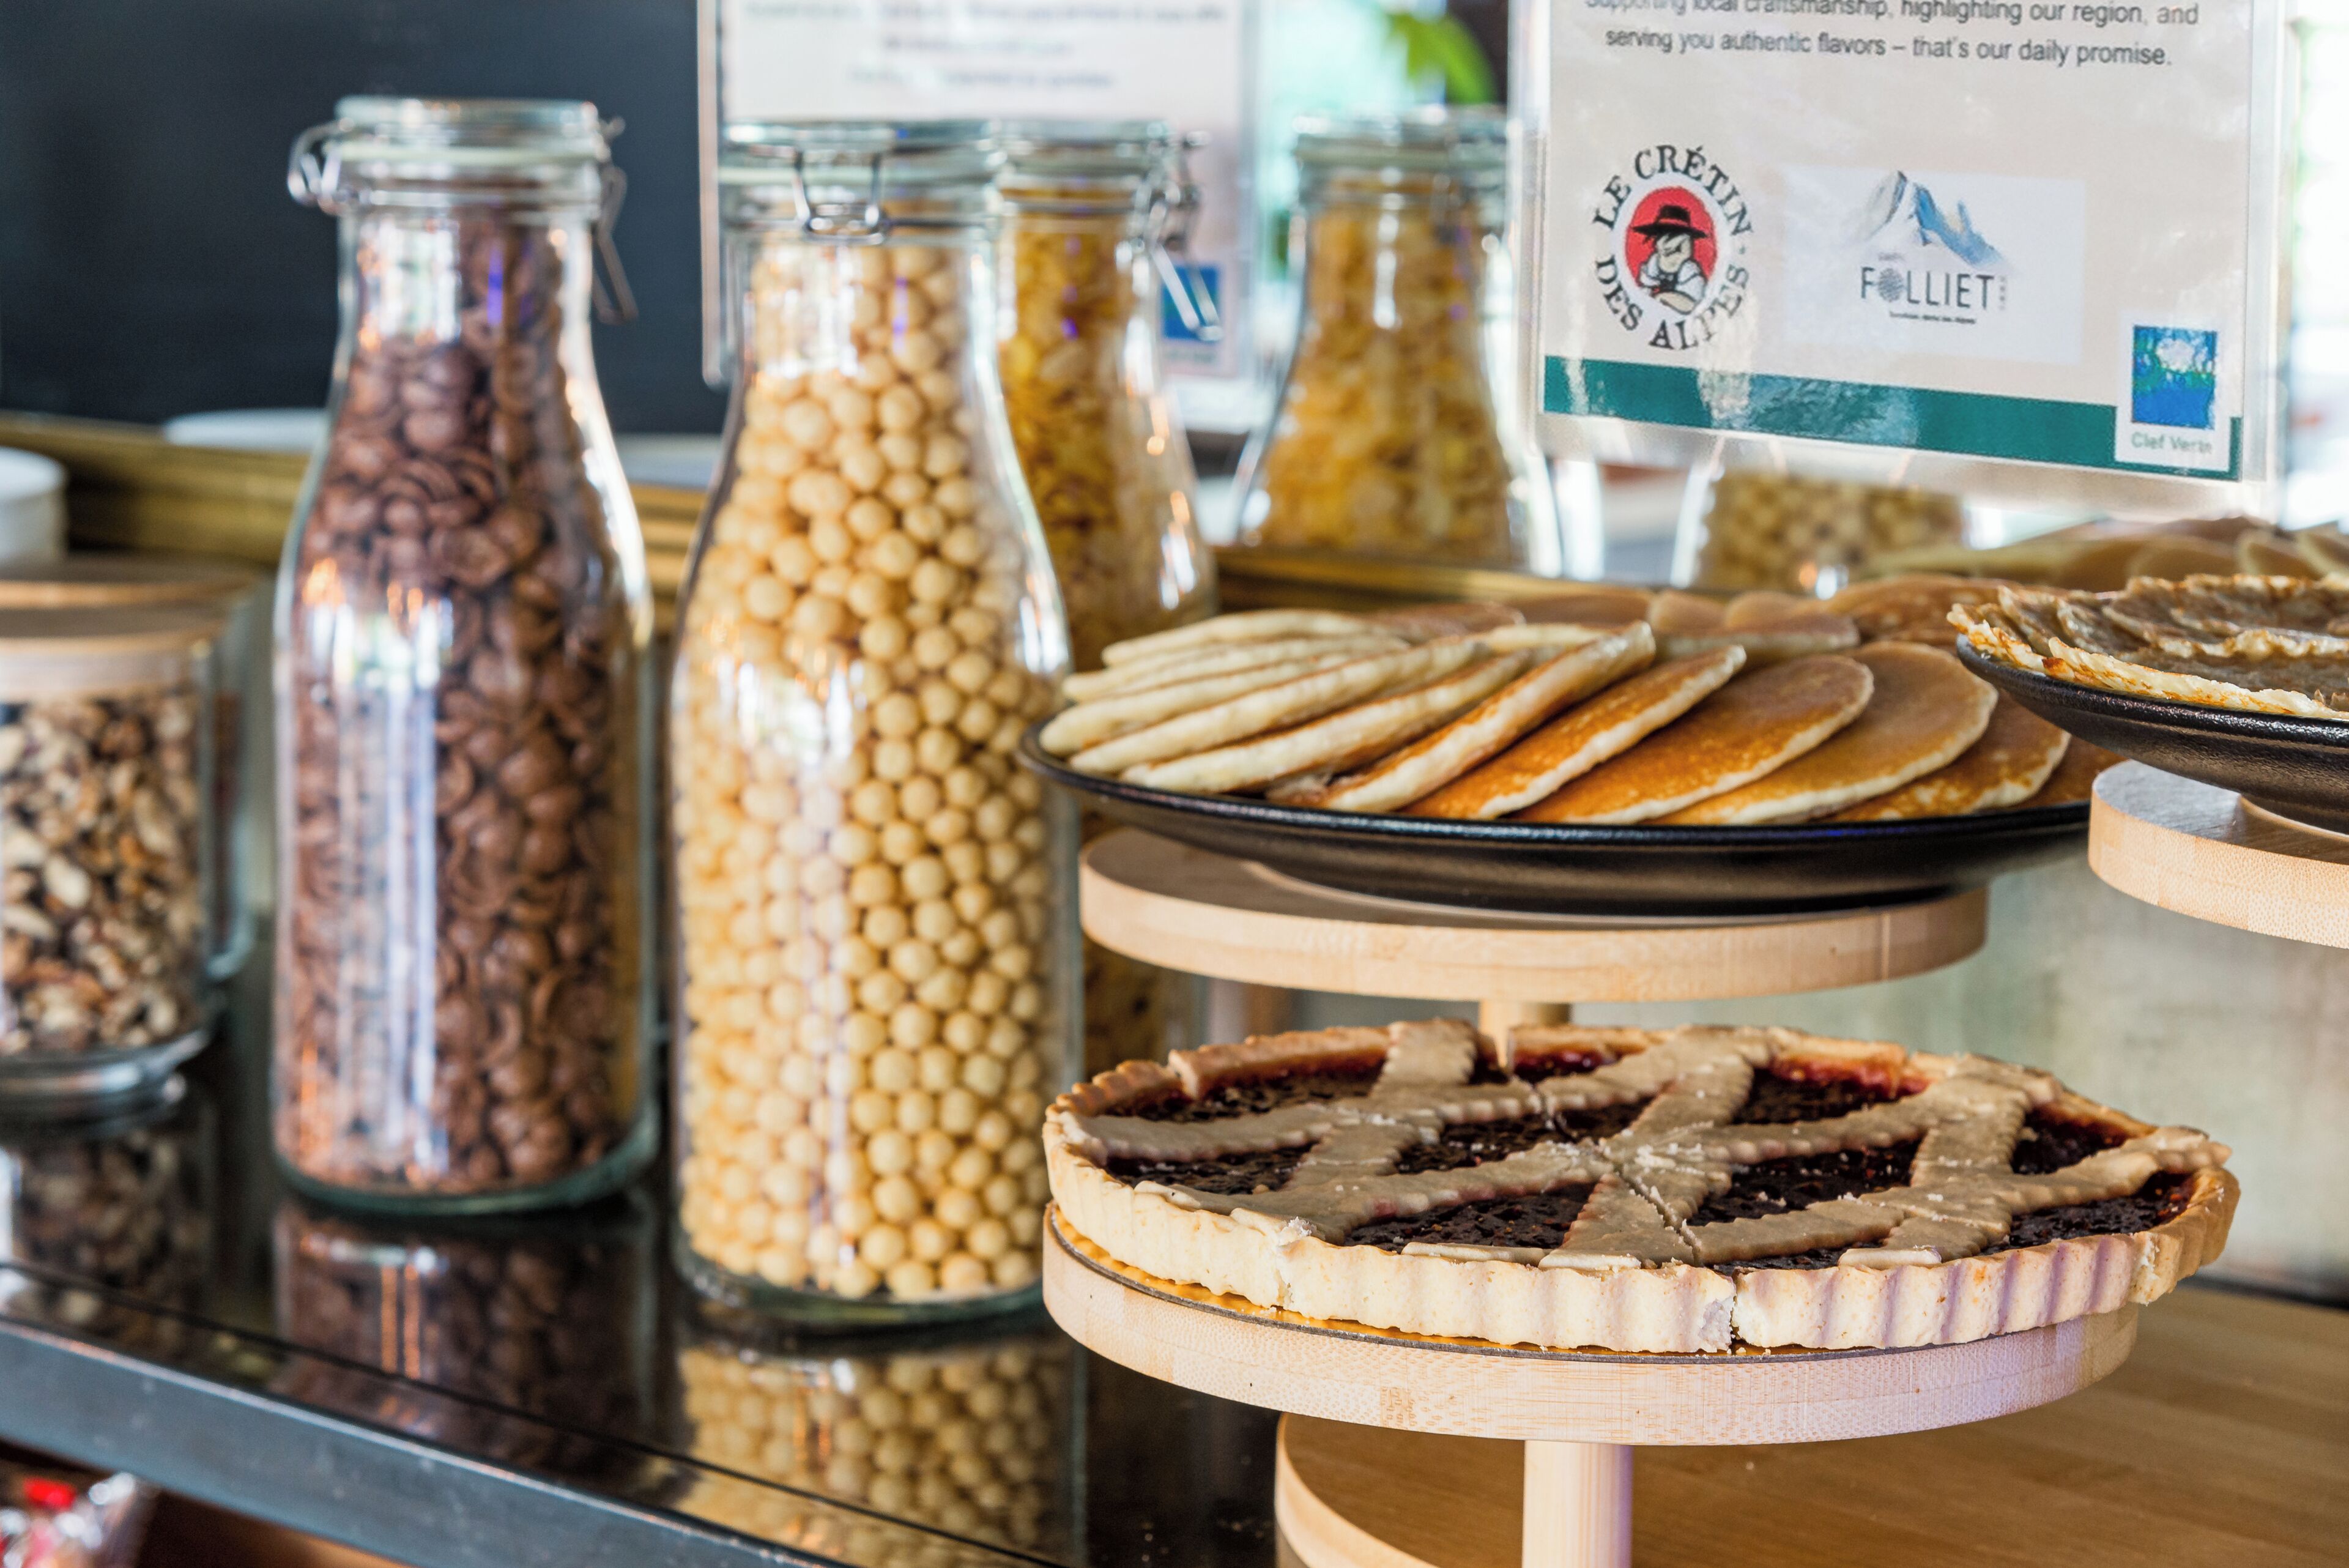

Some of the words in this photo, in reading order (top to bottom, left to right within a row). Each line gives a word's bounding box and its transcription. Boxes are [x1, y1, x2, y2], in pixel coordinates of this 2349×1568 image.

[1899, 0, 2022, 25] highlighting
[2029, 2, 2063, 21] our
[2071, 1, 2148, 27] region,
[2156, 4, 2199, 25] and
[1605, 29, 1673, 53] serving
[1679, 33, 1715, 54] you
[1720, 29, 1811, 53] authentic
[1817, 31, 1887, 55] flavors
[1912, 37, 1969, 58] that's
[1976, 41, 2013, 59] our
[2018, 39, 2069, 67] daily
[2076, 43, 2172, 67] promise.
[1593, 175, 1631, 230] LE
[1635, 145, 1754, 236] CRÉTIN
[1595, 255, 1643, 331] DES
[1648, 263, 1749, 350] ALPES
[2131, 431, 2164, 449] Clef
